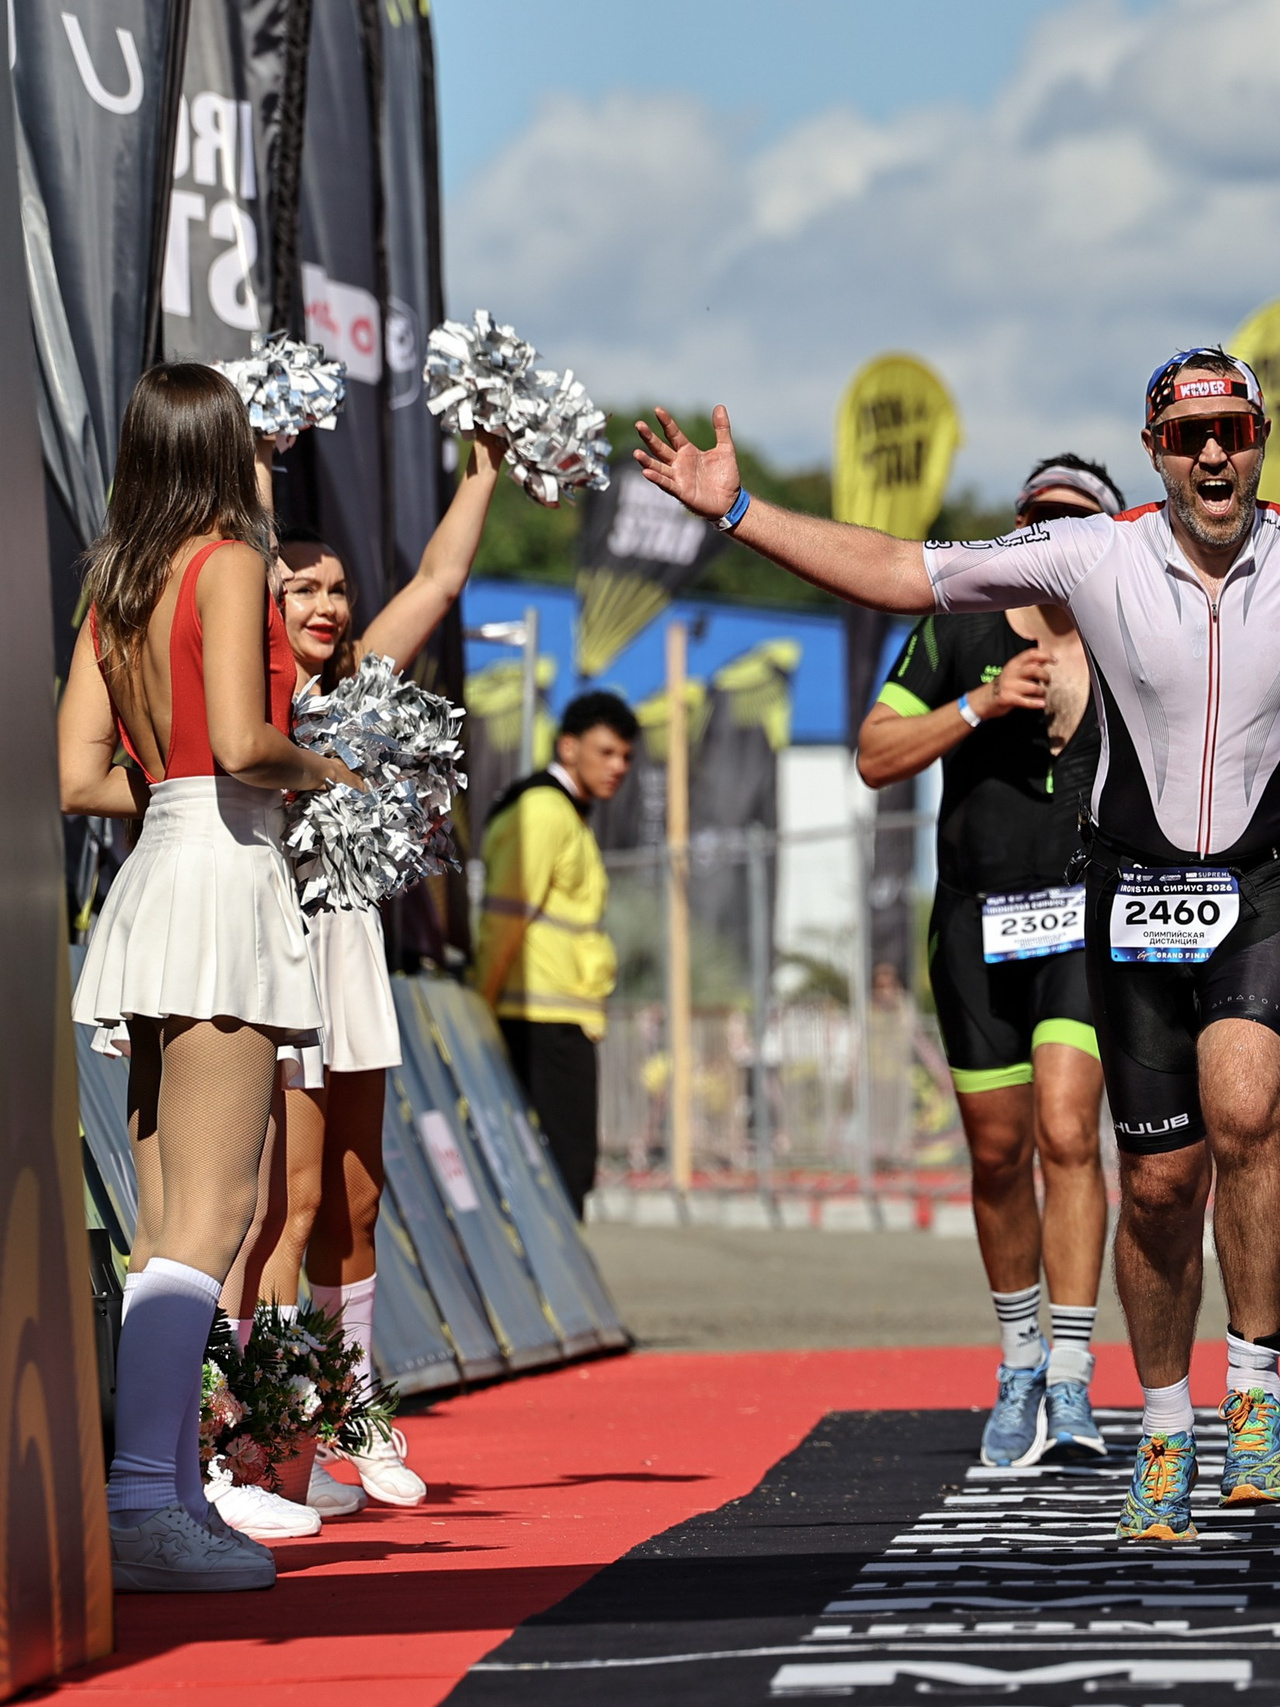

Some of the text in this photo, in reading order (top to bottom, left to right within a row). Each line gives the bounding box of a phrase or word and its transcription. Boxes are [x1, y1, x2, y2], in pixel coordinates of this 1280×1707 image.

[1163, 884, 1204, 892] СИРИУС
[1206, 883, 1233, 892] 2026
[1125, 900, 1221, 925] 2460
[1001, 910, 1078, 936] 2302
[1143, 930, 1205, 938] ОЛИМПИЙСКАЯ
[1185, 951, 1210, 959] FINAL
[1114, 1112, 1190, 1135] HUUB
[811, 1620, 1189, 1637] IRON
